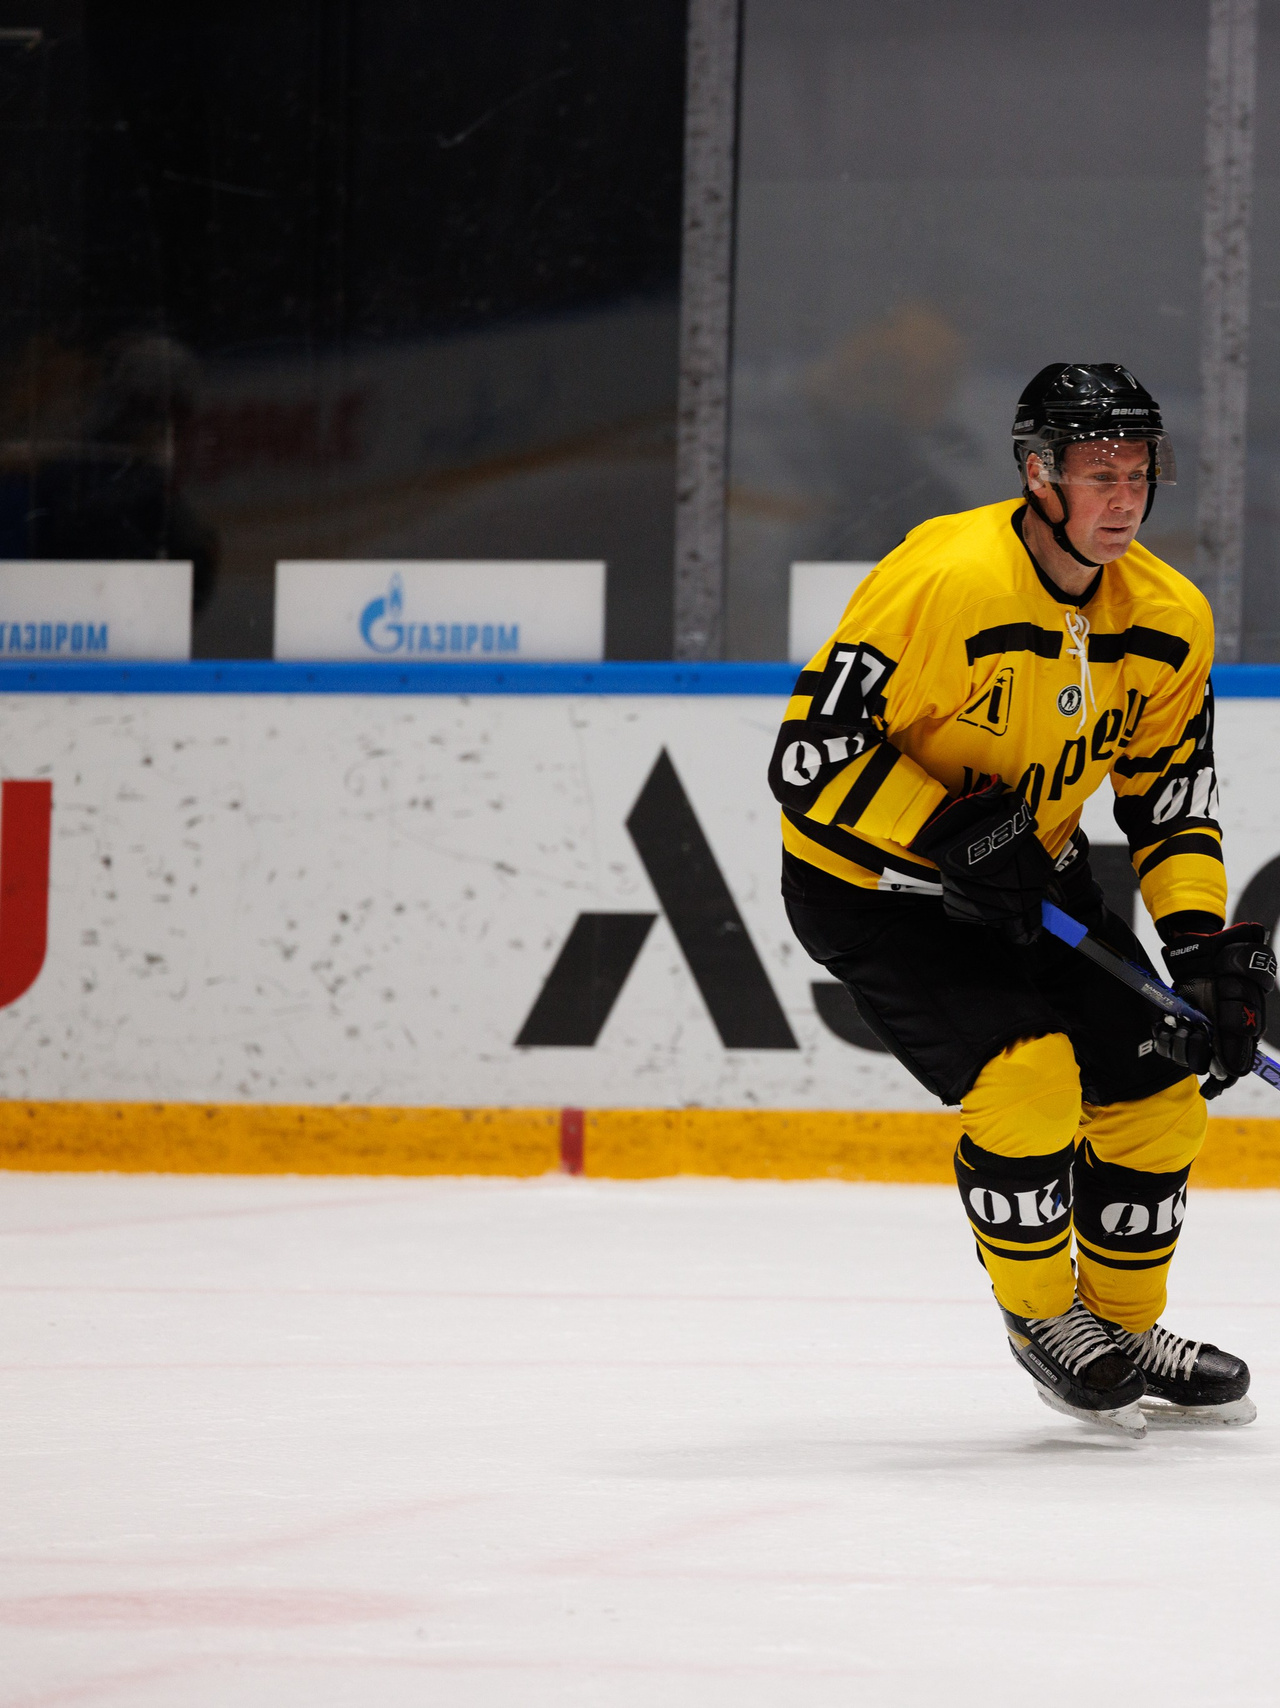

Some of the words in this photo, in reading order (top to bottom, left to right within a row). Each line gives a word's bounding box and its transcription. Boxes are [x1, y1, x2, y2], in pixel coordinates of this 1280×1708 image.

[1111, 408, 1150, 417] BAUER
[968, 797, 1033, 866] BAU
[1169, 943, 1200, 958] BAUER
[1029, 1353, 1058, 1383] BAUER
